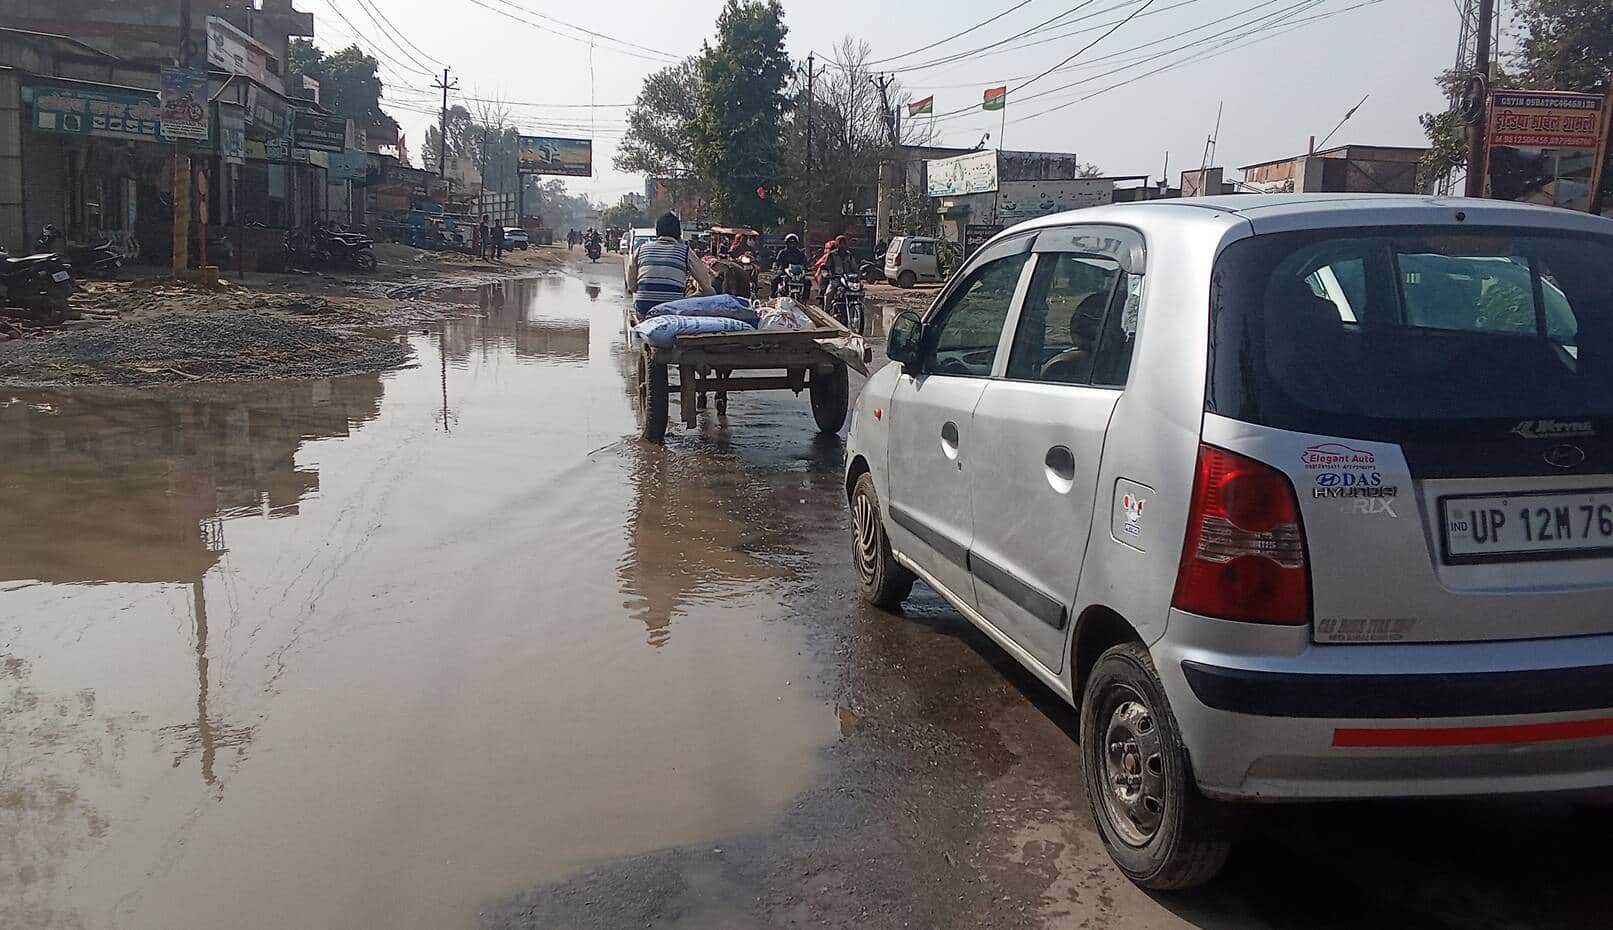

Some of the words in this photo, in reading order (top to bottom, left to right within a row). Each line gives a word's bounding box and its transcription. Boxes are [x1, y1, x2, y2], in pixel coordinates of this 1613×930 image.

[1310, 454, 1349, 464] Elegant
[1352, 455, 1375, 463] Auto
[1343, 472, 1381, 486] DAS
[1450, 521, 1468, 531] IND
[1470, 509, 1506, 544] UP
[1520, 506, 1571, 541] 12M
